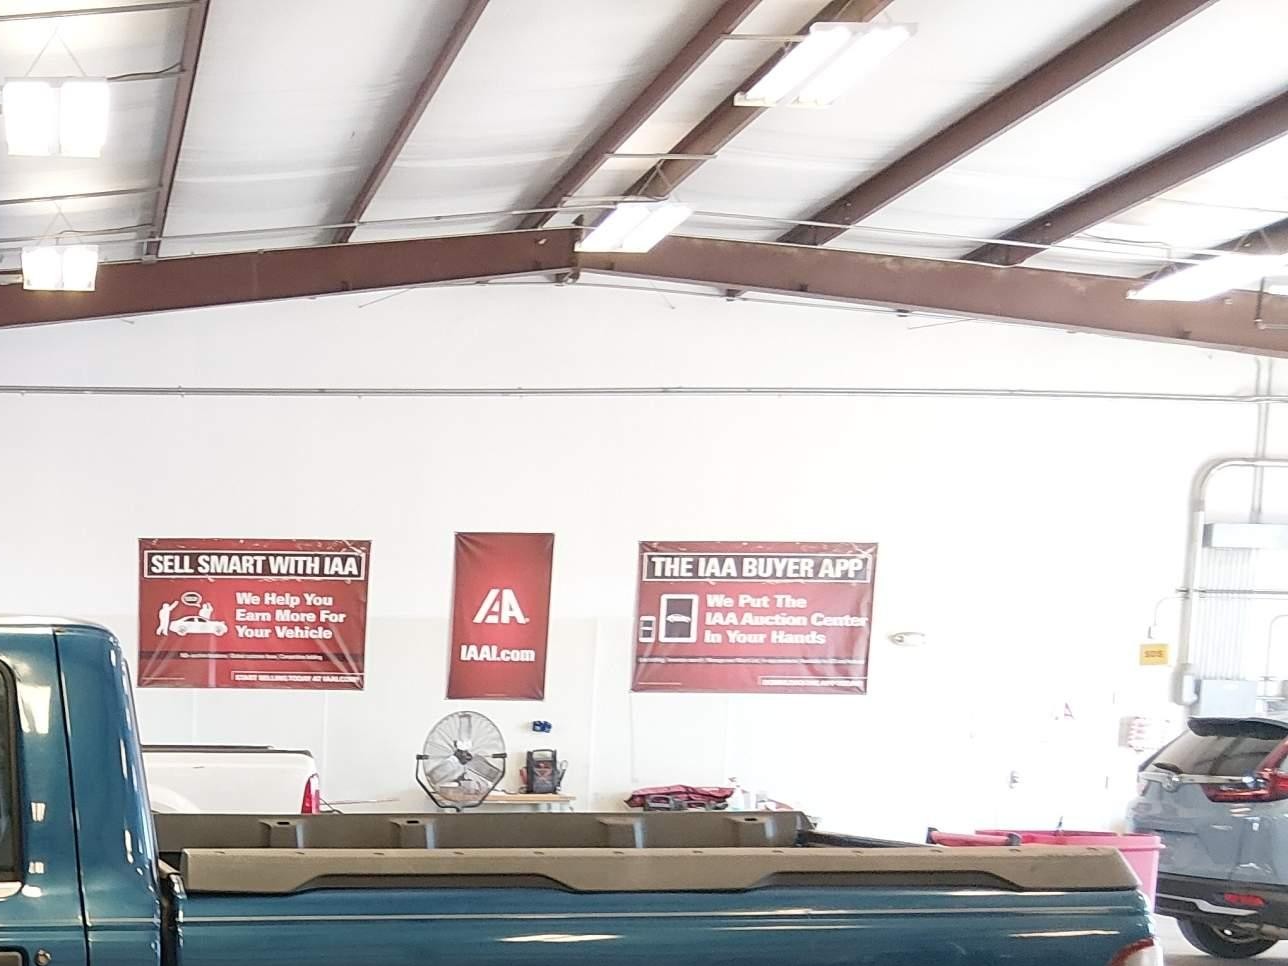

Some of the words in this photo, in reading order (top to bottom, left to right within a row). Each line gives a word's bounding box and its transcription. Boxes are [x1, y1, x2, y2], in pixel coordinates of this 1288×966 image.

[151, 555, 194, 574] SELL
[198, 555, 266, 574] SMART
[269, 556, 320, 575] WITH
[324, 557, 359, 576] IAA
[652, 557, 693, 577] THE
[698, 557, 737, 577] IAA
[742, 558, 815, 578] BUYER
[819, 559, 863, 578] APP
[235, 592, 260, 606] We
[264, 592, 300, 608] Help
[304, 593, 333, 607] You
[706, 594, 735, 608] We
[739, 594, 771, 608] Put
[775, 594, 807, 608] The
[235, 609, 272, 622] Earn
[275, 609, 315, 623] More
[320, 610, 347, 624] For
[705, 612, 739, 626] IAA
[742, 612, 807, 626] Auction
[811, 613, 869, 627] Center
[235, 625, 271, 639] Your
[275, 626, 333, 640] Vehicle
[704, 630, 722, 643] In
[726, 630, 767, 643] Your
[771, 631, 827, 644] Hands
